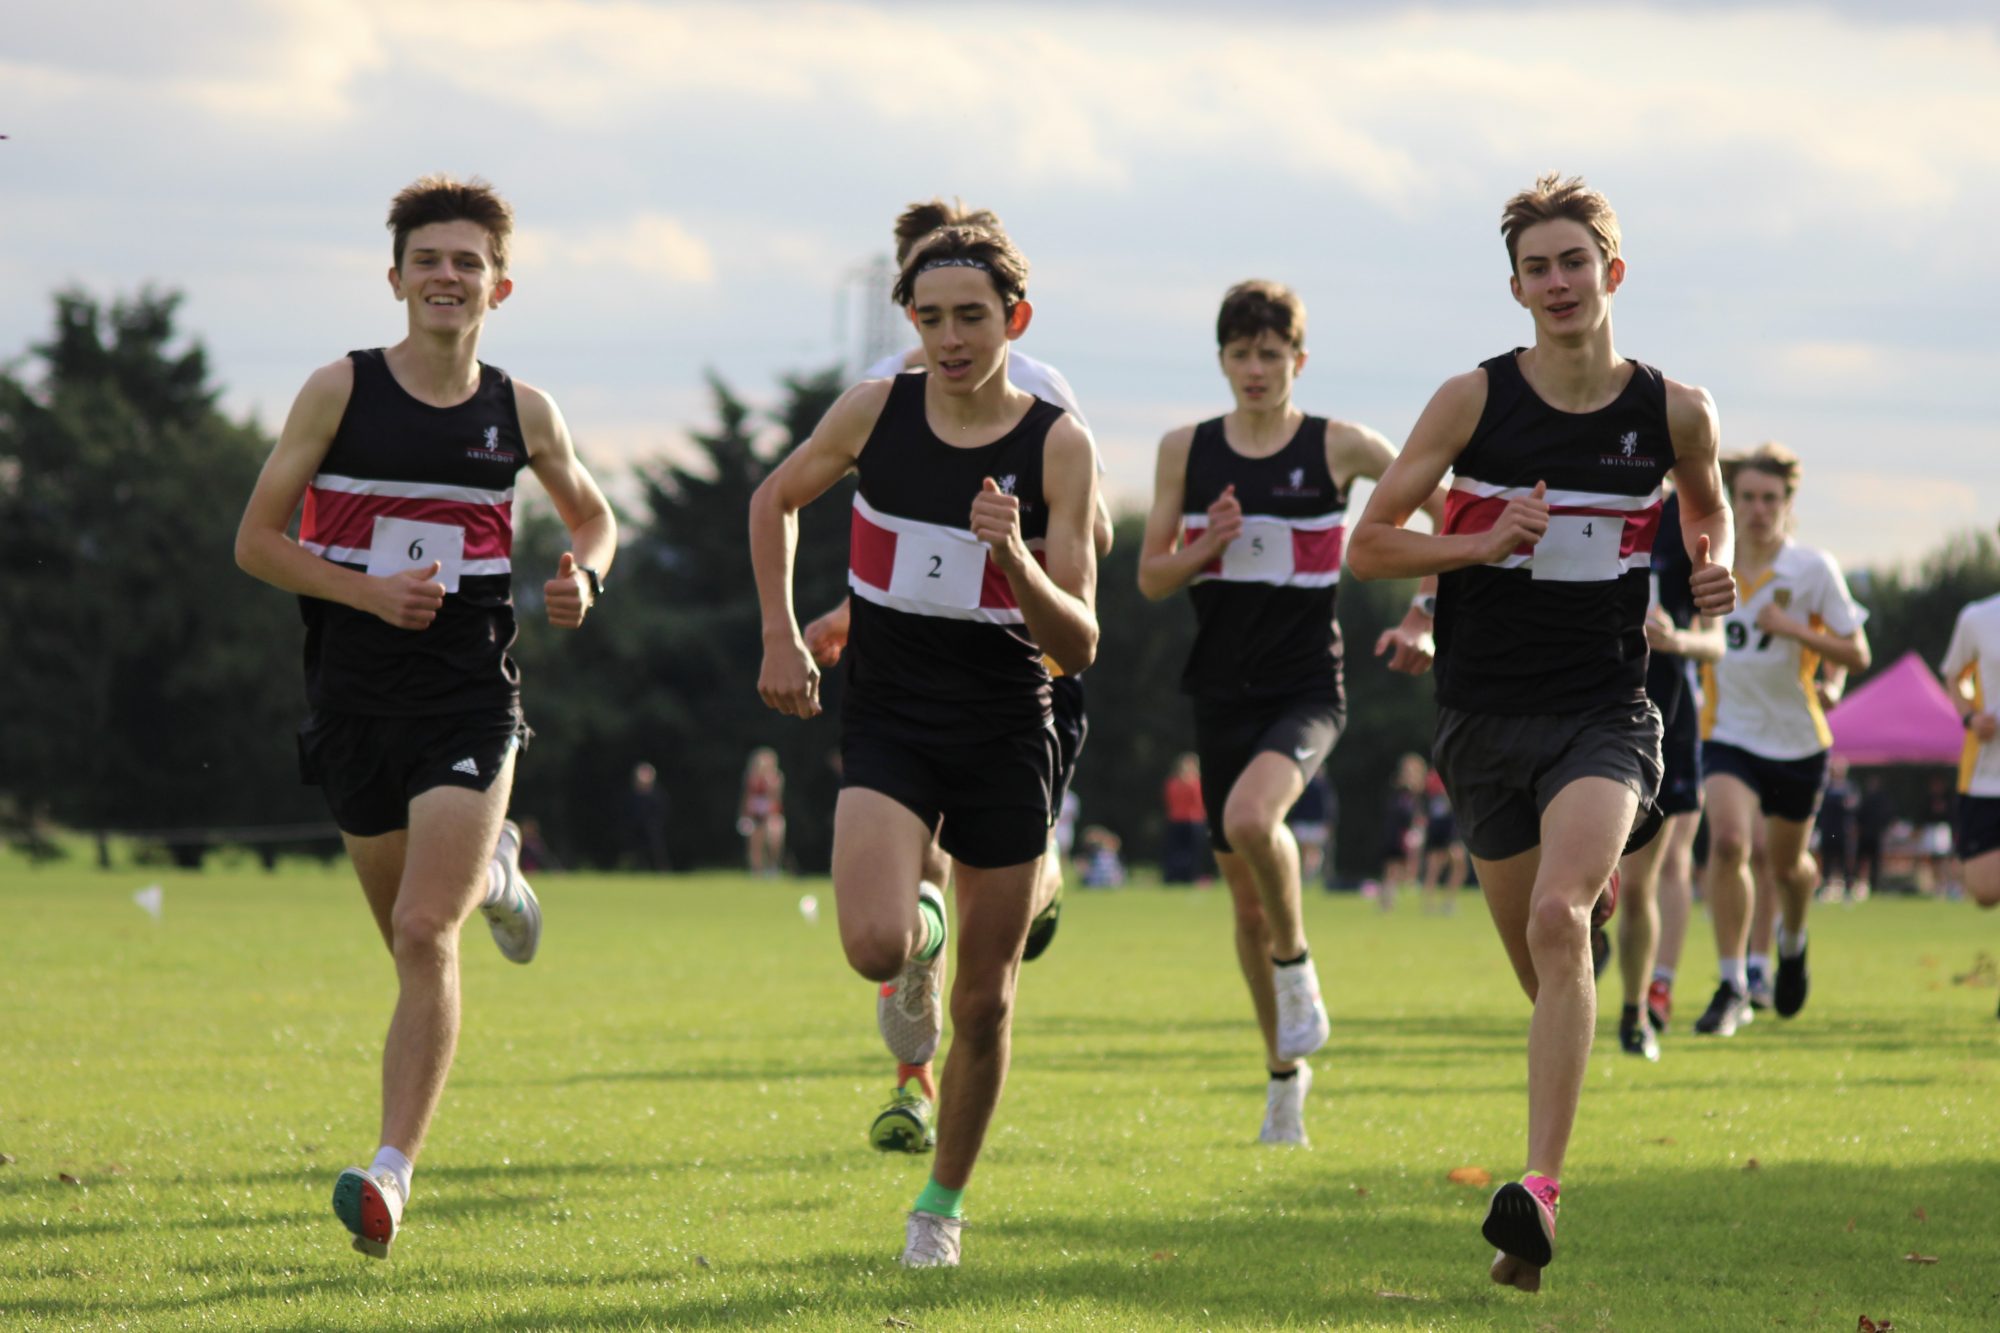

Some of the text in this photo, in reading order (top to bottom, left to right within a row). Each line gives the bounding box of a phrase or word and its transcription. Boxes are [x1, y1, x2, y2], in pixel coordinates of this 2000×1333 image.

[1600, 457, 1656, 468] ABINGDON
[1582, 522, 1593, 538] 4
[408, 538, 424, 561] 6
[1252, 536, 1264, 556] 5
[927, 555, 942, 579] 2
